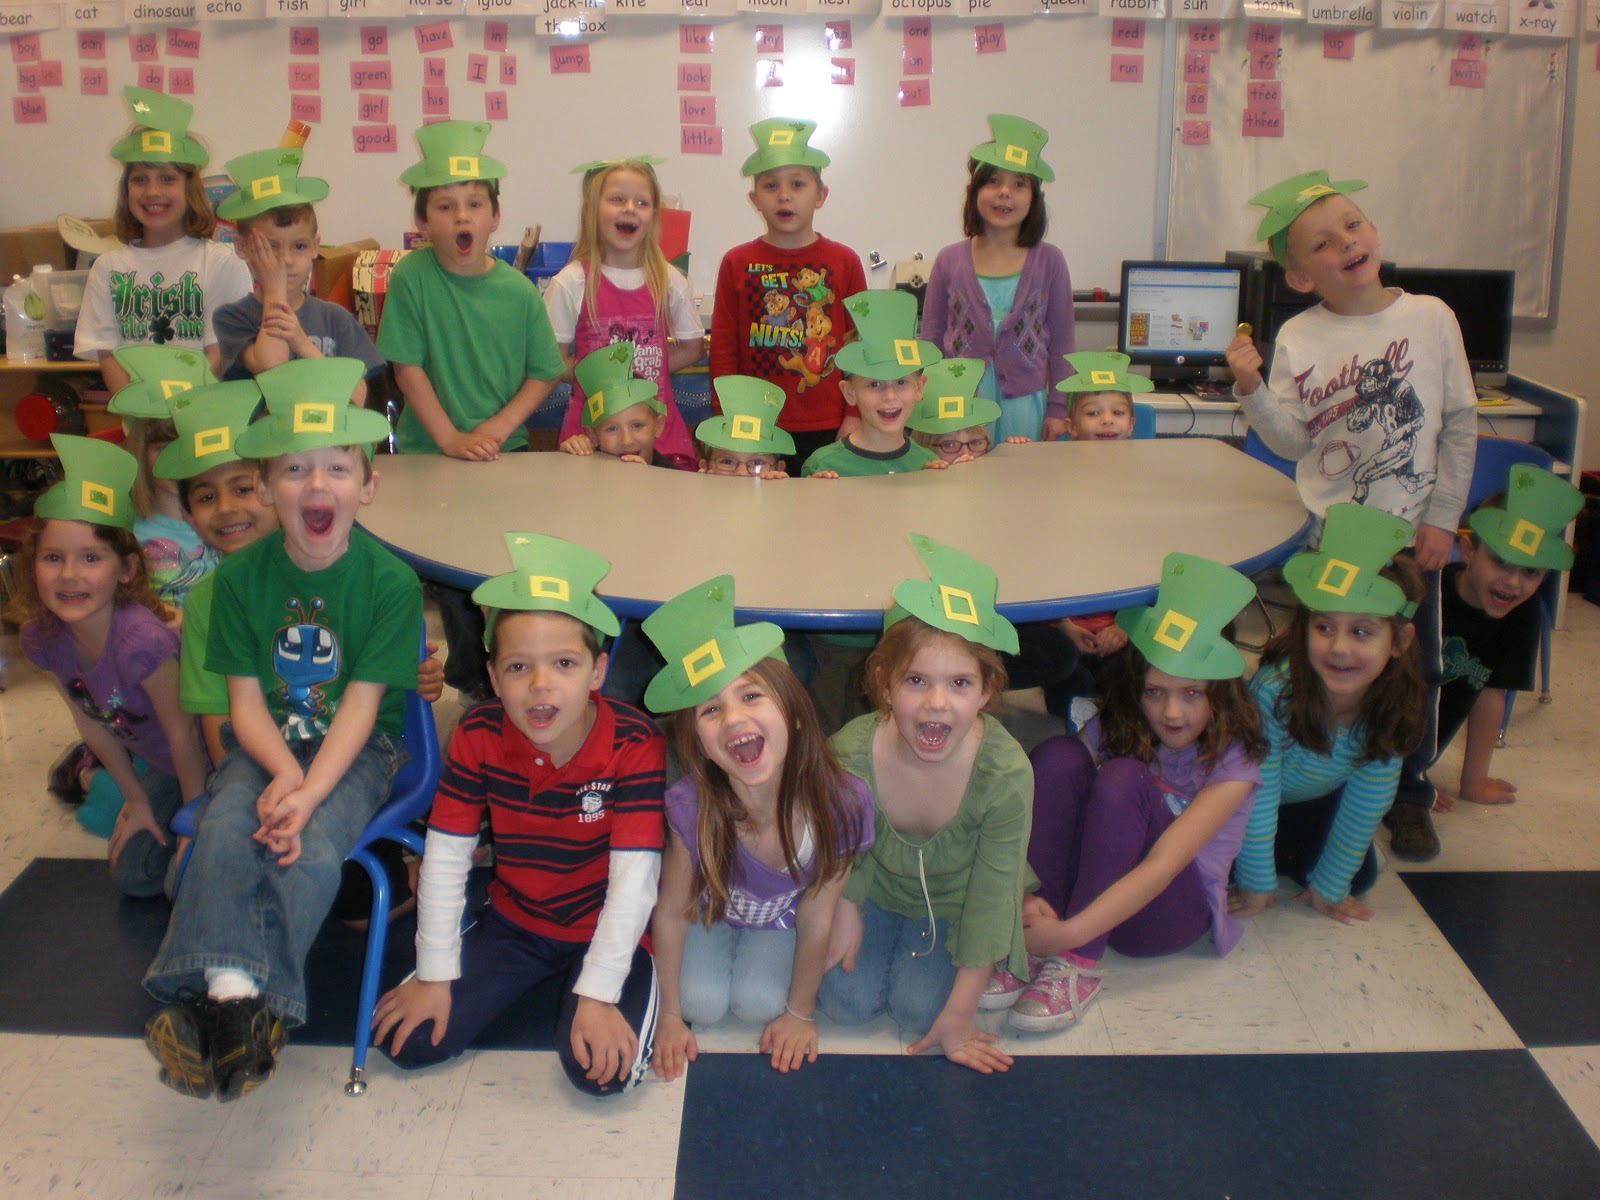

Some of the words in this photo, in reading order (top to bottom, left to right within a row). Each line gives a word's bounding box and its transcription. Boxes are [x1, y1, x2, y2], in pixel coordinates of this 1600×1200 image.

[133, 4, 196, 18] dinosaur
[206, 0, 242, 13] echo
[278, 0, 309, 10] fish
[339, 0, 366, 11] girl
[891, 0, 952, 11] octopus
[968, 0, 992, 13] pie
[1110, 0, 1158, 9] rabbit
[1183, 0, 1209, 10] sun
[1254, 0, 1295, 10] tooth
[0, 13, 32, 25] bear
[75, 6, 98, 20] cat
[1312, 7, 1373, 21] umbrella
[1392, 8, 1428, 21] violin
[1456, 10, 1497, 24] watch
[578, 17, 607, 32] box
[1520, 17, 1557, 33] x-ray
[419, 31, 448, 45] have
[491, 30, 502, 42] in
[685, 30, 707, 44] like
[908, 27, 929, 37] one
[1117, 27, 1139, 39] red
[1193, 30, 1216, 42] see
[1254, 31, 1275, 43] the
[169, 32, 198, 50] down
[293, 34, 313, 46] fun
[367, 36, 384, 50] go
[763, 34, 780, 47] my
[978, 30, 1002, 50] play
[1328, 39, 1344, 51] up
[136, 40, 155, 55] day
[553, 54, 584, 69] jump
[909, 57, 923, 66] on
[1119, 62, 1138, 74] run
[1187, 60, 1207, 73] she
[1258, 58, 1273, 70] to
[429, 63, 444, 77] he
[473, 63, 484, 80] I
[504, 62, 514, 76] is
[682, 67, 707, 83] look
[1455, 66, 1481, 80] with
[19, 68, 36, 88] big
[83, 71, 101, 86] cat
[145, 69, 160, 84] do
[354, 70, 387, 85] green
[426, 93, 444, 107] his
[1190, 94, 1205, 104] so
[1250, 89, 1277, 101] tree
[21, 100, 42, 115] blue
[363, 100, 384, 118] girl
[490, 97, 501, 111] it
[684, 100, 706, 115] love
[1248, 113, 1279, 128] three
[356, 128, 391, 152] good
[683, 130, 713, 145] little
[748, 263, 773, 273] LET'S
[760, 272, 789, 289] GET
[109, 270, 204, 320] Irish
[749, 322, 803, 348] NUTS!
[807, 346, 821, 366] A
[634, 356, 661, 372] grab
[1293, 337, 1415, 408] Footbll
[575, 781, 612, 796] ALL-STAR
[578, 809, 605, 823] 1895
